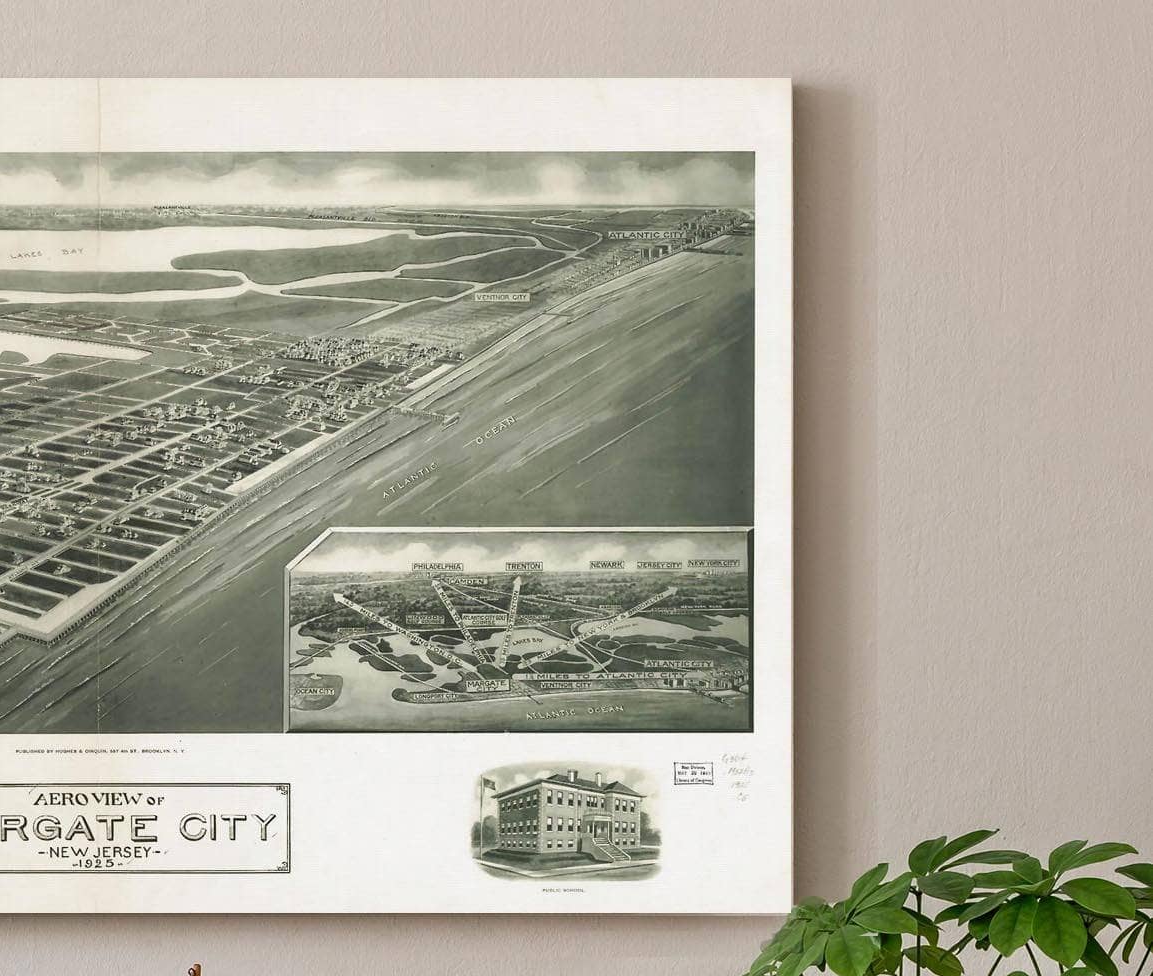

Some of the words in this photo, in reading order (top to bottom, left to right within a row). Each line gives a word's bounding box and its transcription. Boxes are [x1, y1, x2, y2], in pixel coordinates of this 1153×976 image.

[609, 231, 660, 239] ATLANTIC
[663, 231, 685, 239] CITY
[61, 247, 84, 256] BAY
[382, 462, 438, 499] ATLANTIC
[475, 415, 517, 445] OCEAN
[413, 563, 462, 571] PHILADELPHIA
[507, 562, 542, 570] TRENTON
[577, 628, 596, 641] NEW
[597, 617, 618, 632] YORK
[396, 626, 445, 656] WASHINGTON
[646, 660, 690, 668] ATLANTIC
[660, 671, 687, 679] CITY
[467, 680, 506, 688] MARGATE
[526, 708, 576, 720] ATLANTIC
[587, 705, 625, 714] OCEAN
[33, 792, 89, 806] AERO
[91, 792, 143, 806] VIEW
[179, 813, 278, 842] CITY
